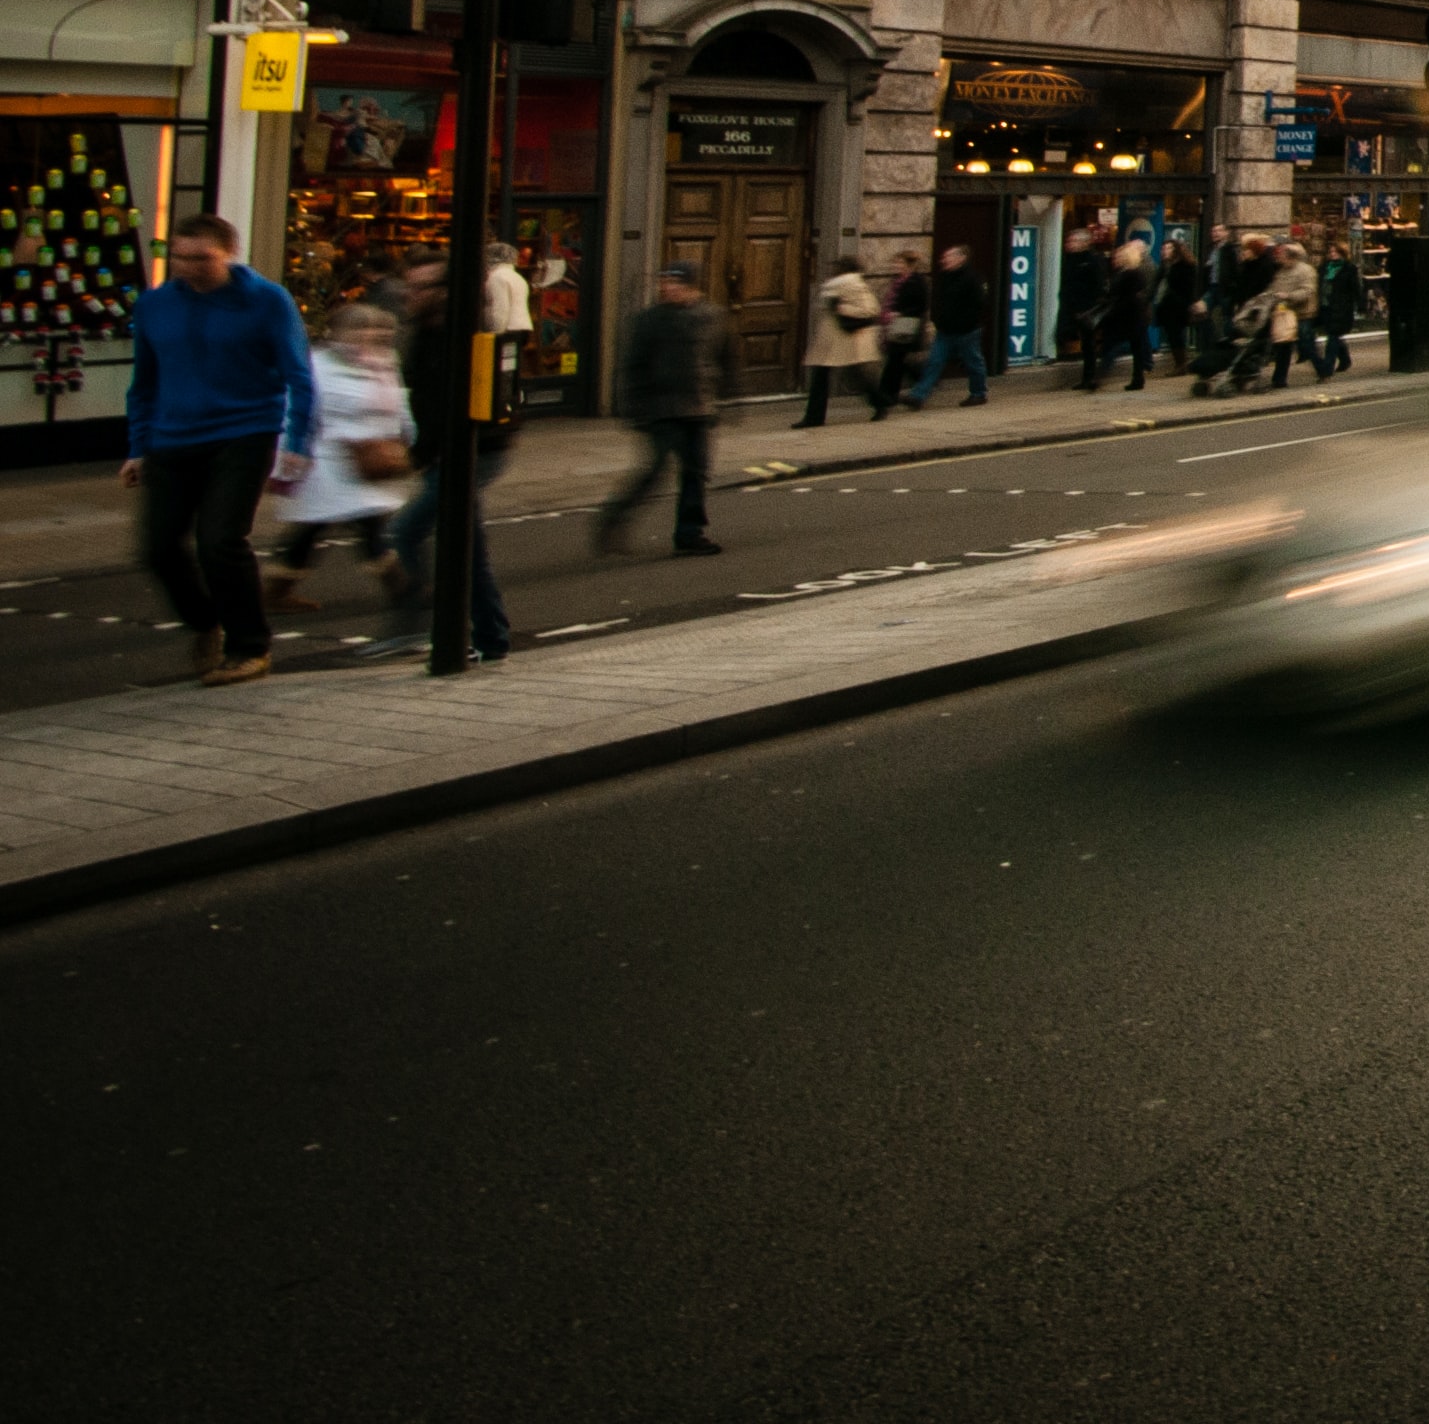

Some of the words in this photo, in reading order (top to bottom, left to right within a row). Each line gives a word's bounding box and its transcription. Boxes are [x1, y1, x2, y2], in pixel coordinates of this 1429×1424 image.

[254, 51, 288, 82] itsu
[955, 84, 1012, 102] MONEY
[679, 115, 749, 126] FOXGLOVE
[753, 116, 796, 127] HOUSE
[724, 130, 751, 142] 166
[1277, 130, 1315, 141] MONEY
[699, 144, 775, 155] PICCADILLY
[1276, 143, 1315, 154] CHANGE
[1010, 229, 1031, 353] MONEY
[737, 561, 962, 600] LOOK
[964, 522, 1149, 557] LEFT
